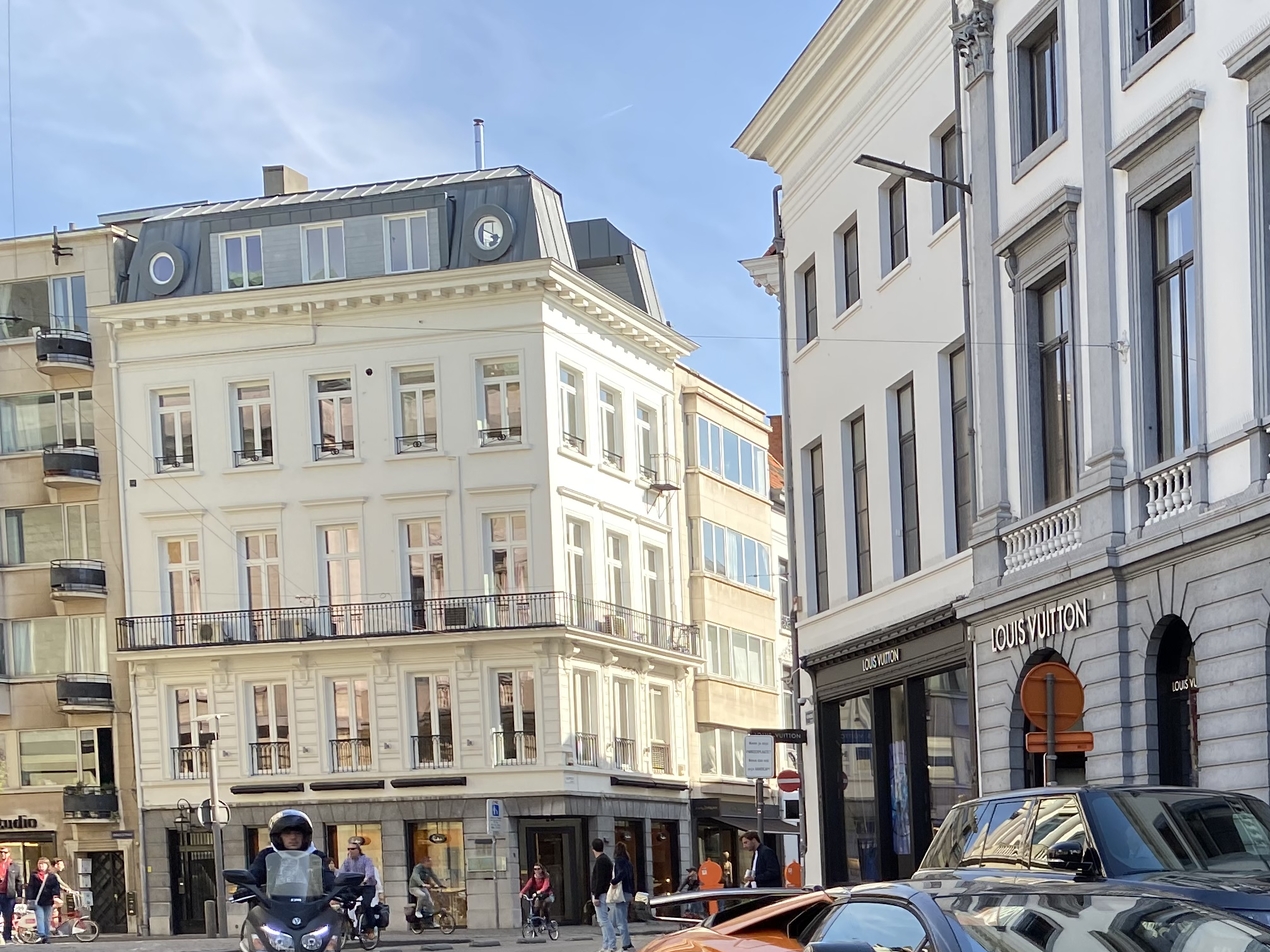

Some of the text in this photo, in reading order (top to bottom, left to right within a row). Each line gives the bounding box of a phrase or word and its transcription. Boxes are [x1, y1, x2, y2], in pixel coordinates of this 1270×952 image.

[991, 598, 1089, 653] LOUIS VUITTON
[862, 648, 899, 671] LOUIS VUITTON
[1172, 679, 1188, 692] LOUIS
